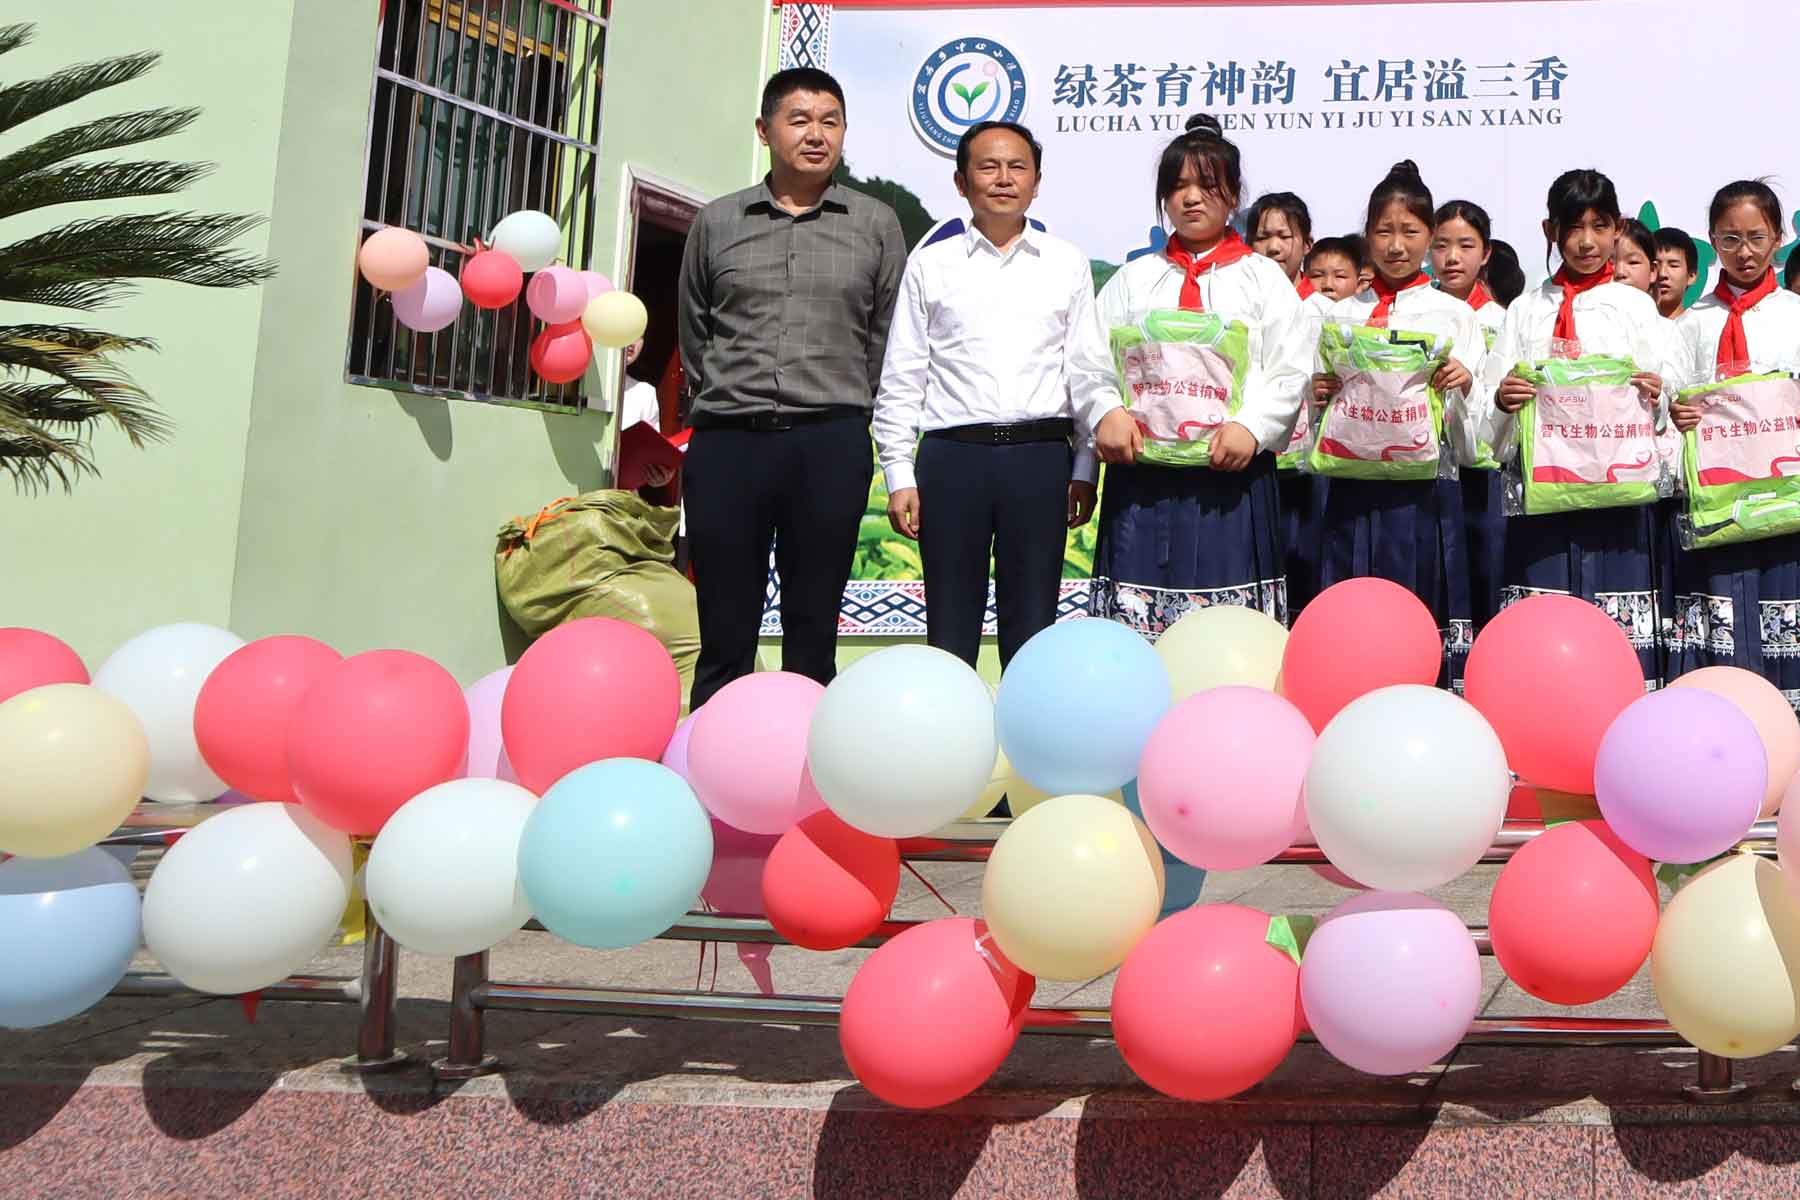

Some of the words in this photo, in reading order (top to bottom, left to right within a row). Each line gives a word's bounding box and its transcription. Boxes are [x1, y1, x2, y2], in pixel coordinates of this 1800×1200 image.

[1052, 60, 1297, 109] 绿茶育神韵
[1323, 55, 1568, 102] 宜居溢三香
[1056, 115, 1142, 132] LUCHA
[1150, 114, 1180, 131] YU
[1264, 112, 1314, 129] YUN
[1321, 111, 1345, 128] YI
[1352, 111, 1382, 128] JU
[1391, 110, 1414, 127] YI
[1422, 109, 1472, 127] SAN
[1480, 108, 1562, 126] XIANG
